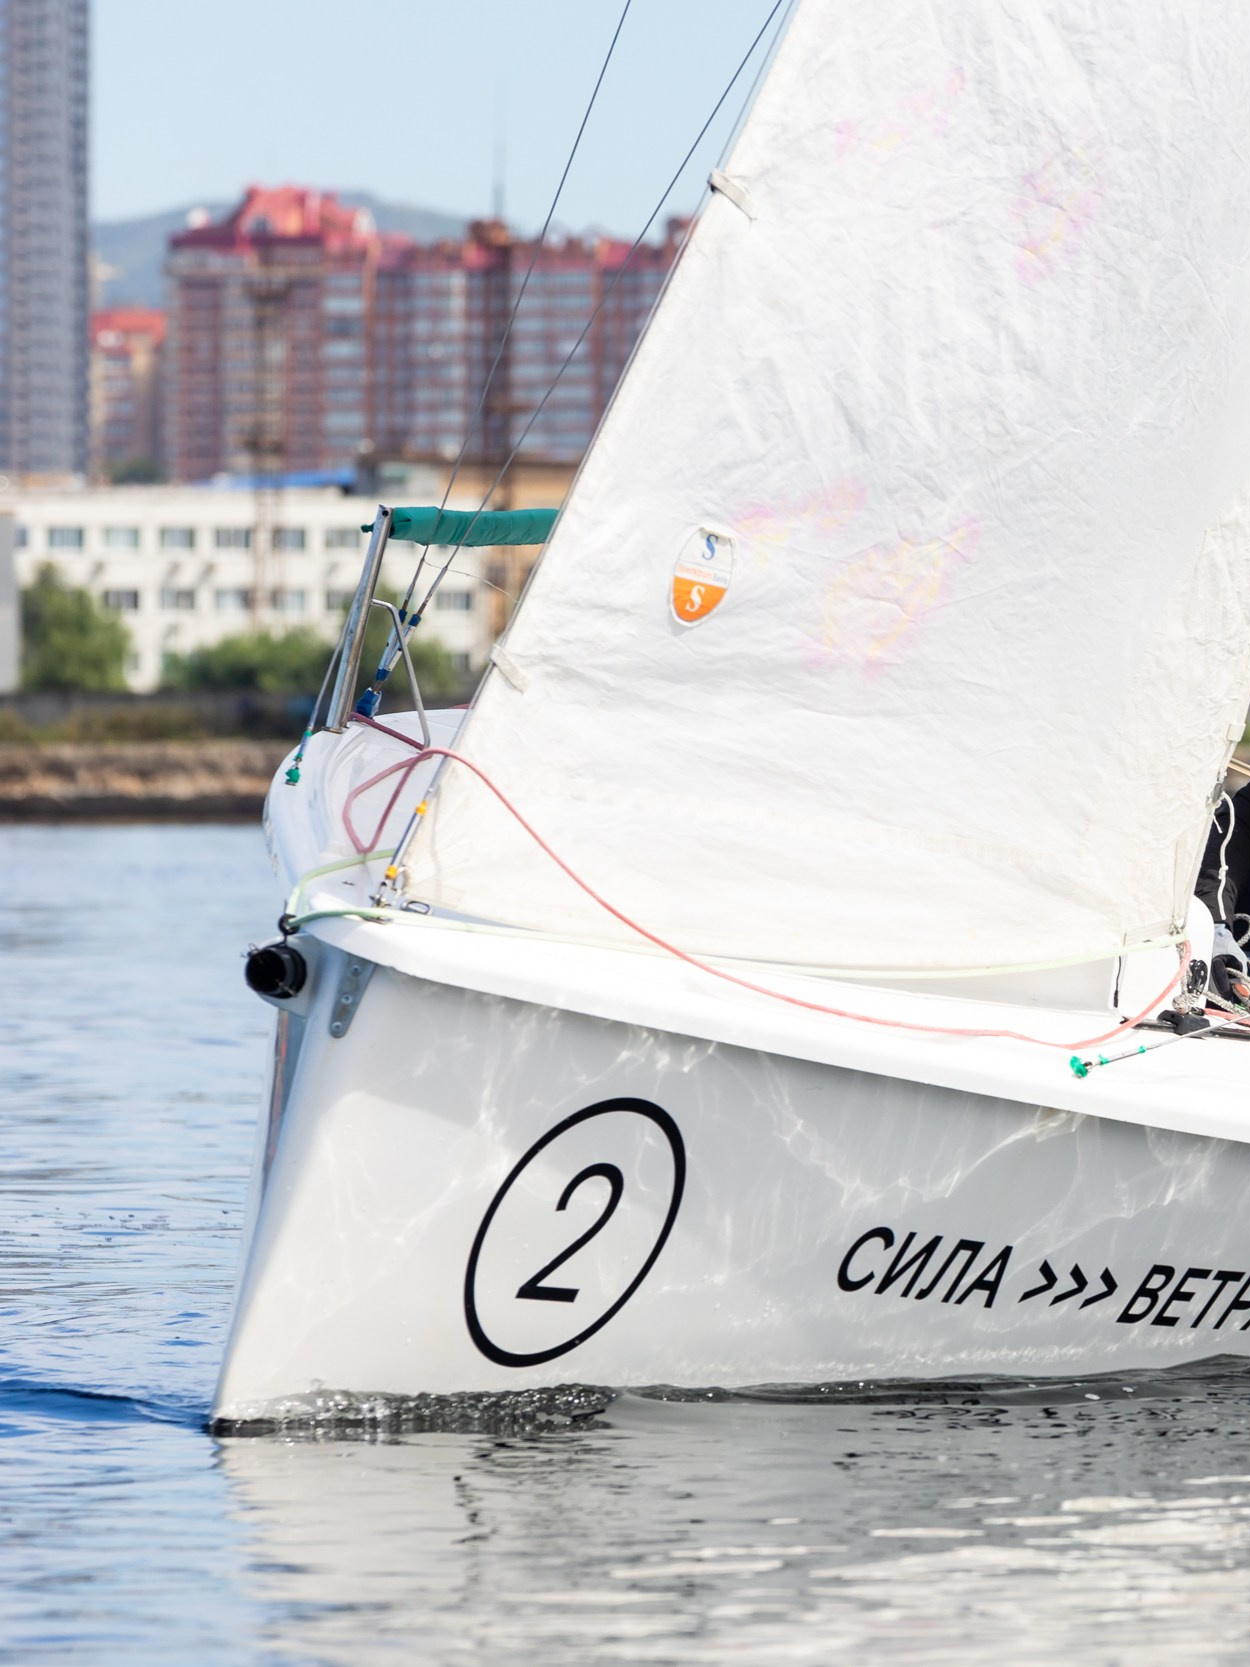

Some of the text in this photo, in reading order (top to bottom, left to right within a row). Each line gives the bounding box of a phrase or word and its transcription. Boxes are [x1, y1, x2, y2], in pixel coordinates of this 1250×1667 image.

[702, 533, 719, 560] S
[685, 584, 706, 612] S
[515, 1163, 624, 1303] 2
[836, 1226, 1013, 1308] СИЛА
